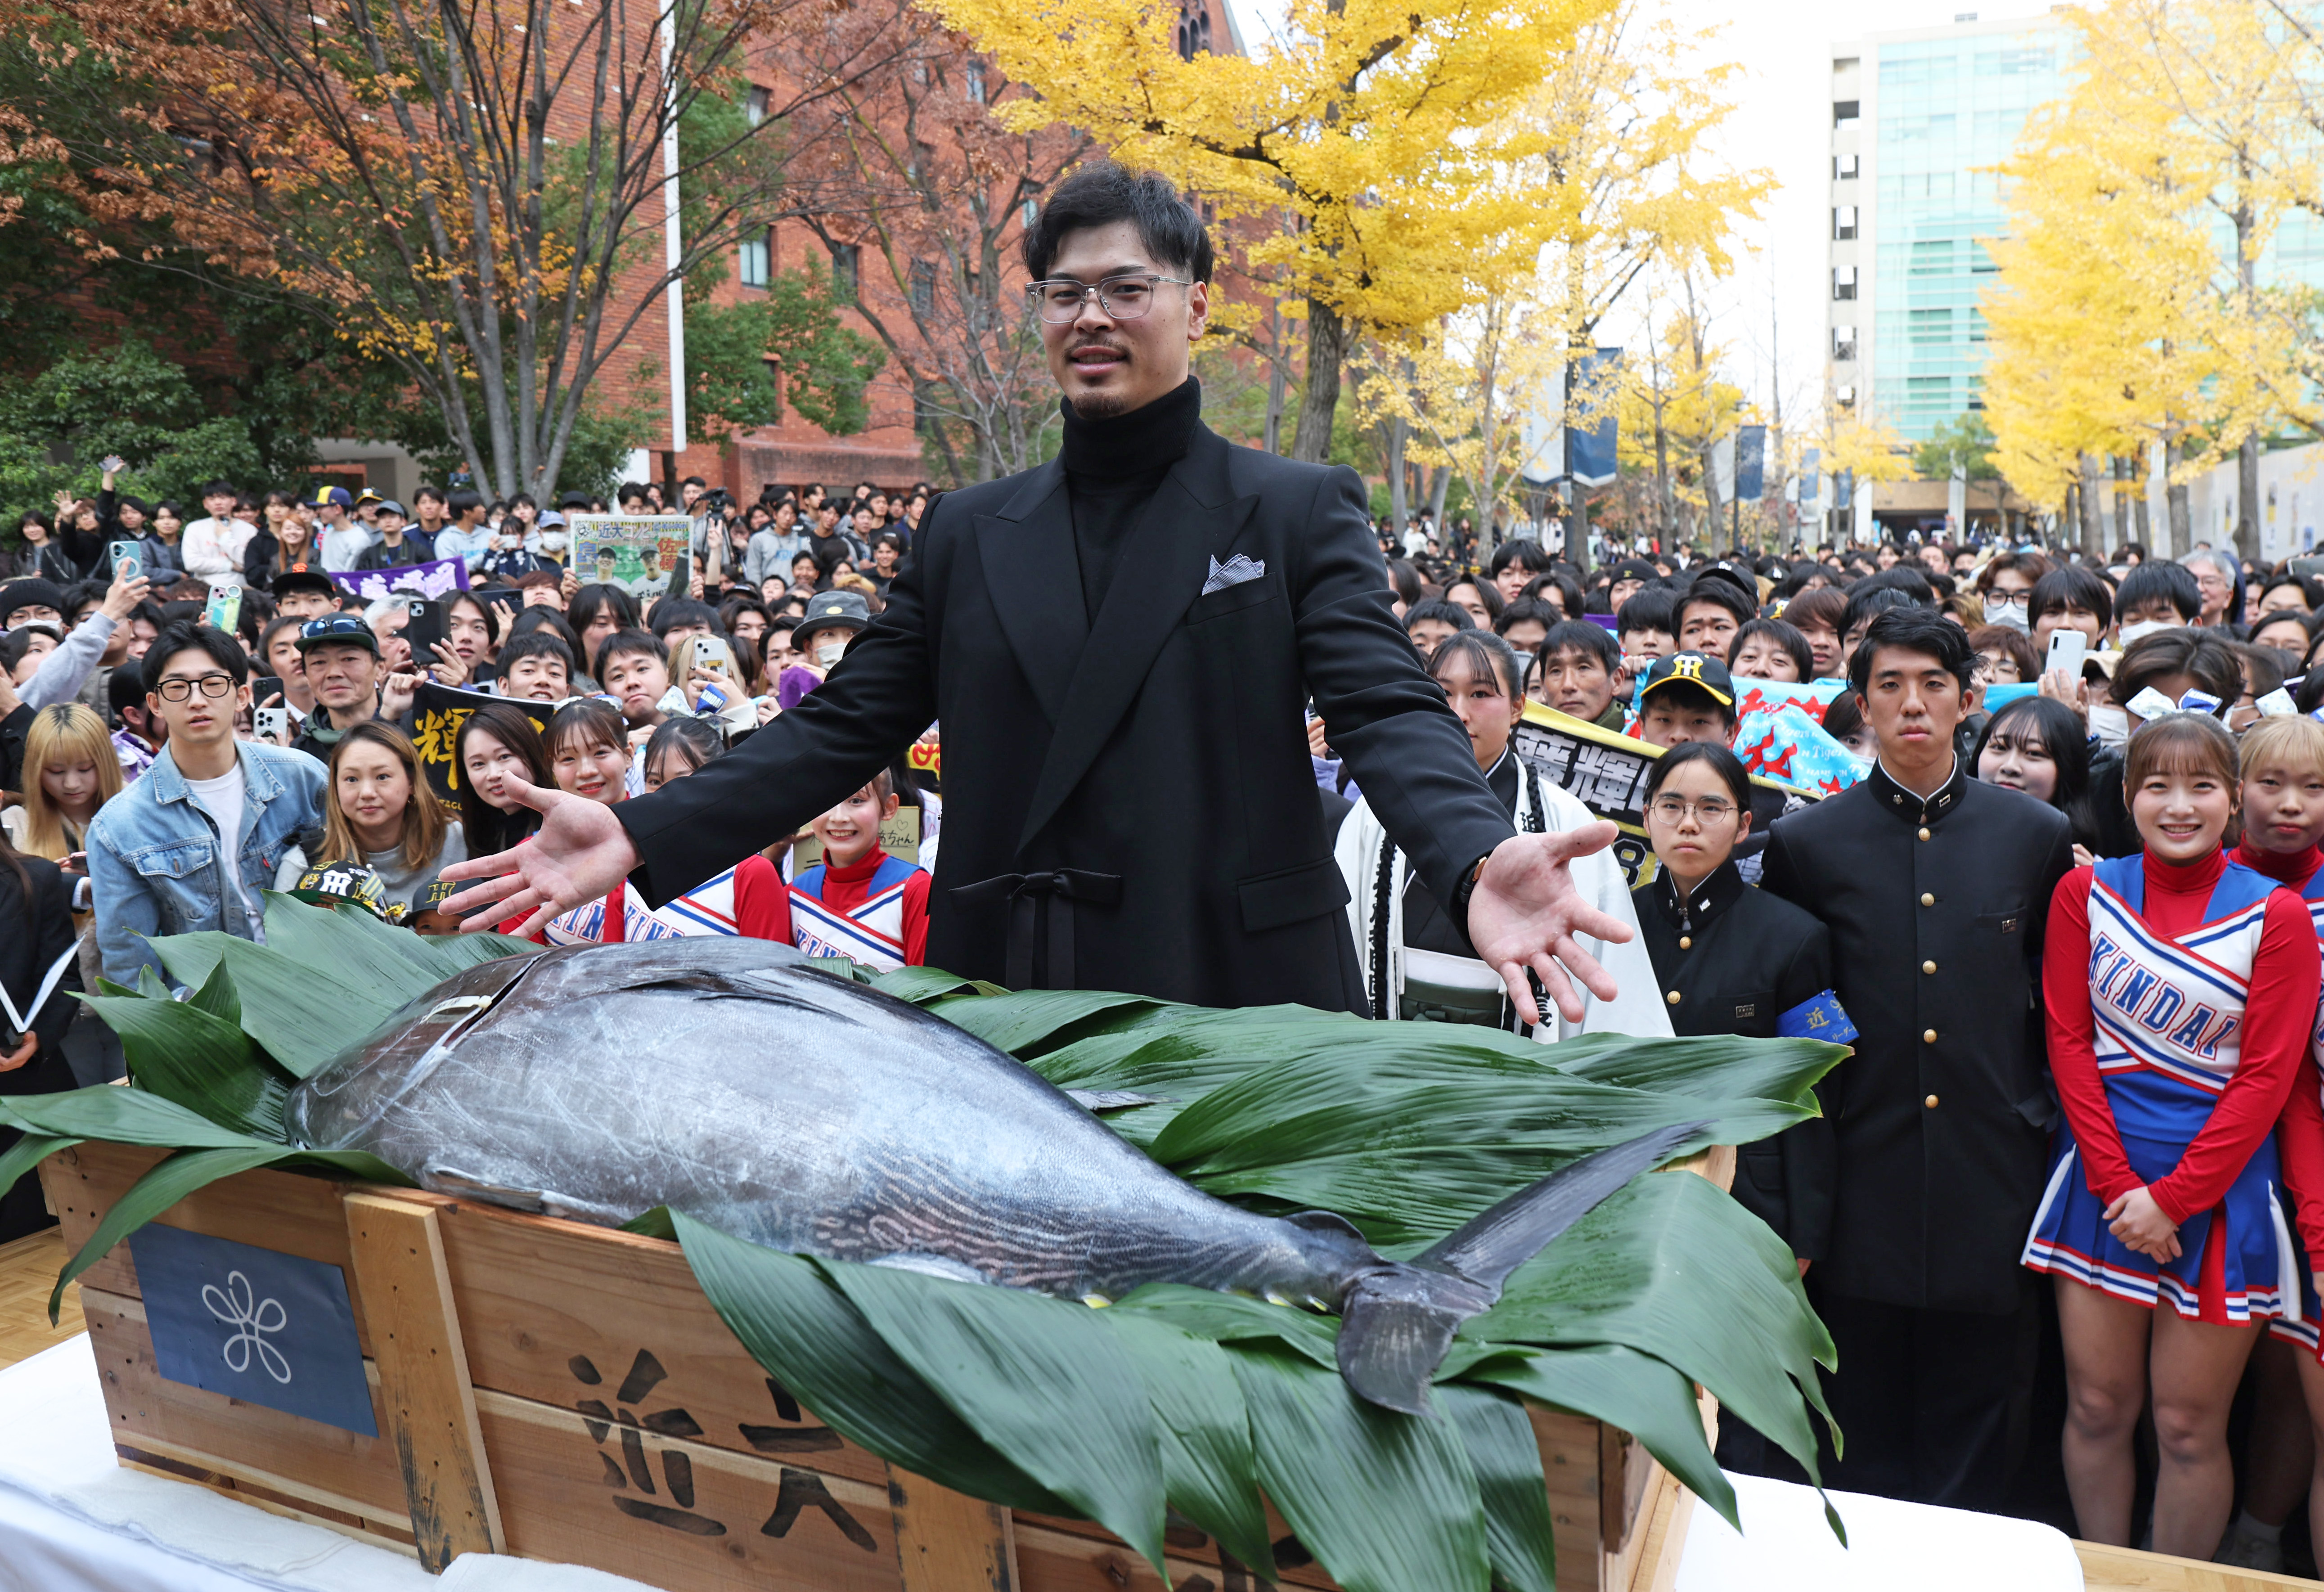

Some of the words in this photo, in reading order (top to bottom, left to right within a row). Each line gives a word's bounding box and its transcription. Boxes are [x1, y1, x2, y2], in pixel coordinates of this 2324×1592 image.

[701, 689, 724, 709] KINDAI
[1812, 745, 1843, 760] Tiger
[2088, 931, 2240, 1061] KINDAI
[1805, 1007, 1830, 1030] 近
